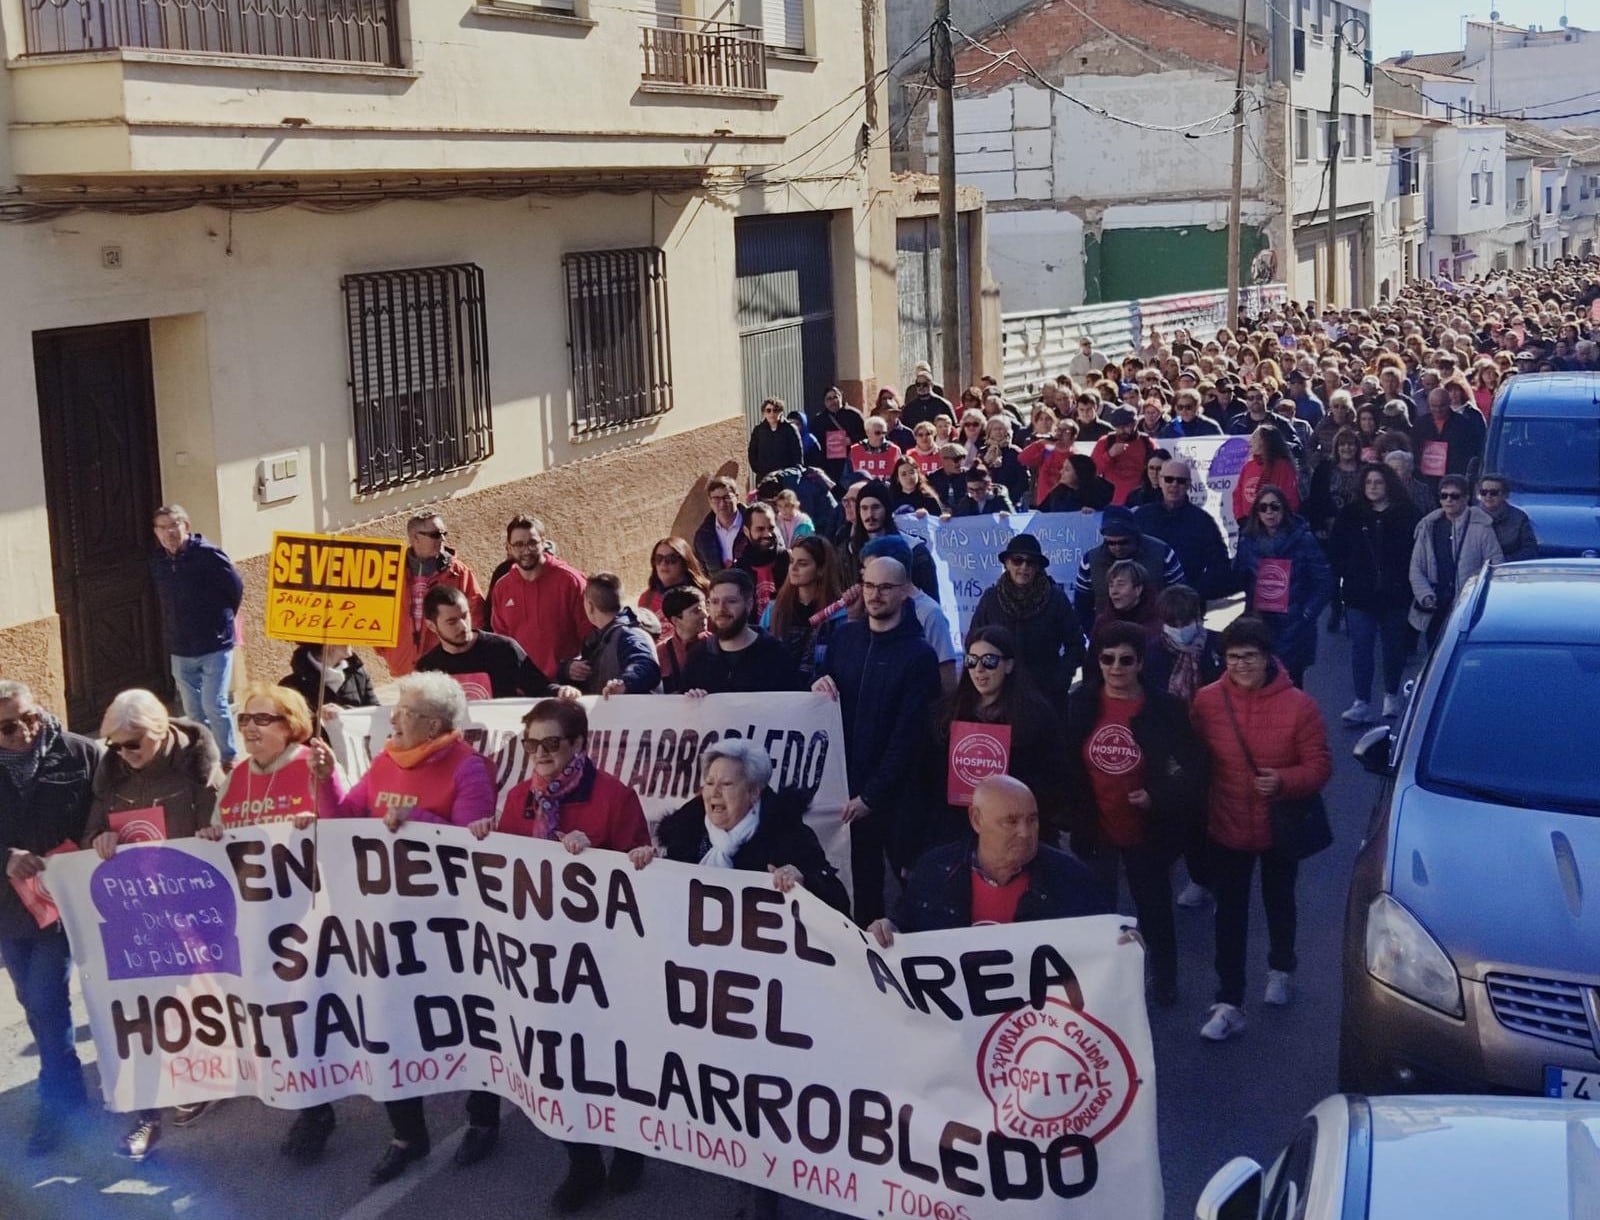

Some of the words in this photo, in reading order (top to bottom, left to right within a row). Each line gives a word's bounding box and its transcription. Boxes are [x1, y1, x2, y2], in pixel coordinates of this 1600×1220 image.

[858, 459, 886, 470] POR
[921, 462, 938, 471] OR
[274, 542, 306, 584] SE
[309, 545, 399, 590] VENDE
[954, 756, 1004, 770] HOSPITAL
[1091, 743, 1139, 758] HOSPITAL
[241, 797, 275, 818] POR
[102, 869, 216, 898] Plataforma
[226, 838, 321, 902] EN
[352, 835, 645, 938] DEFENSA
[687, 878, 836, 967] DEL
[124, 949, 143, 969] lo
[268, 915, 610, 1009] SANITARIA
[664, 959, 814, 1051] DEL
[989, 1066, 1112, 1097] HOSPITAL
[111, 993, 390, 1060] HOSPITAL
[414, 994, 503, 1053] DE
[511, 1015, 1098, 1202] VILLARROBLEDO
[169, 1055, 225, 1090] POR
[388, 1052, 467, 1089] 100%
[586, 1102, 616, 1133] DE
[792, 1158, 858, 1202] PARA
[1002, 1087, 1113, 1139] VILLARROBLEDO
